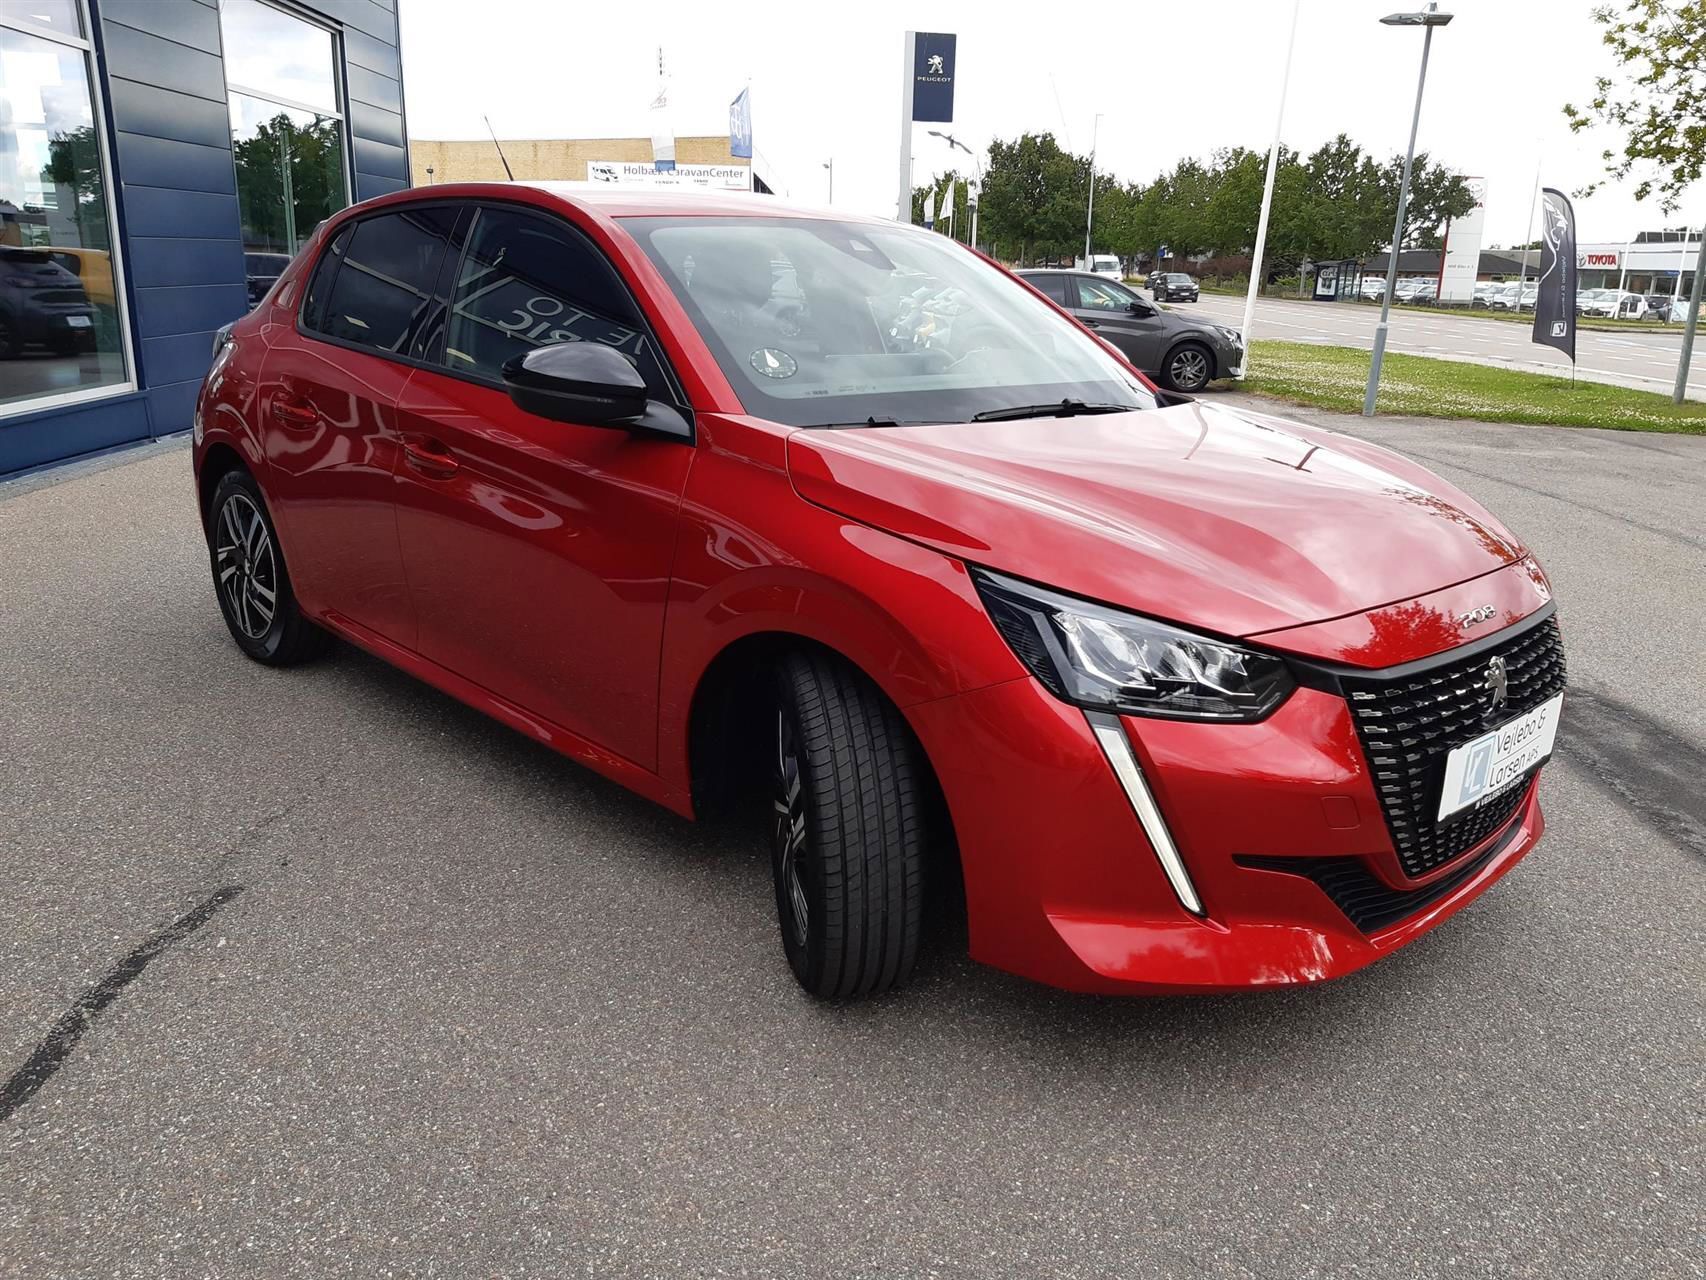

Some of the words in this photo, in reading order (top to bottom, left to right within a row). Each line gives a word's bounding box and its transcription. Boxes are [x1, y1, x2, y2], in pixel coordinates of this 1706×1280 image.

[623, 165, 664, 176] Holbæk
[667, 167, 744, 178] CaravanCenter
[1587, 254, 1617, 265] TOYOTA
[1460, 604, 1496, 628] 208
[1497, 720, 1536, 754] Vejlebo
[1537, 708, 1547, 729] &
[1489, 753, 1525, 788] Larsen
